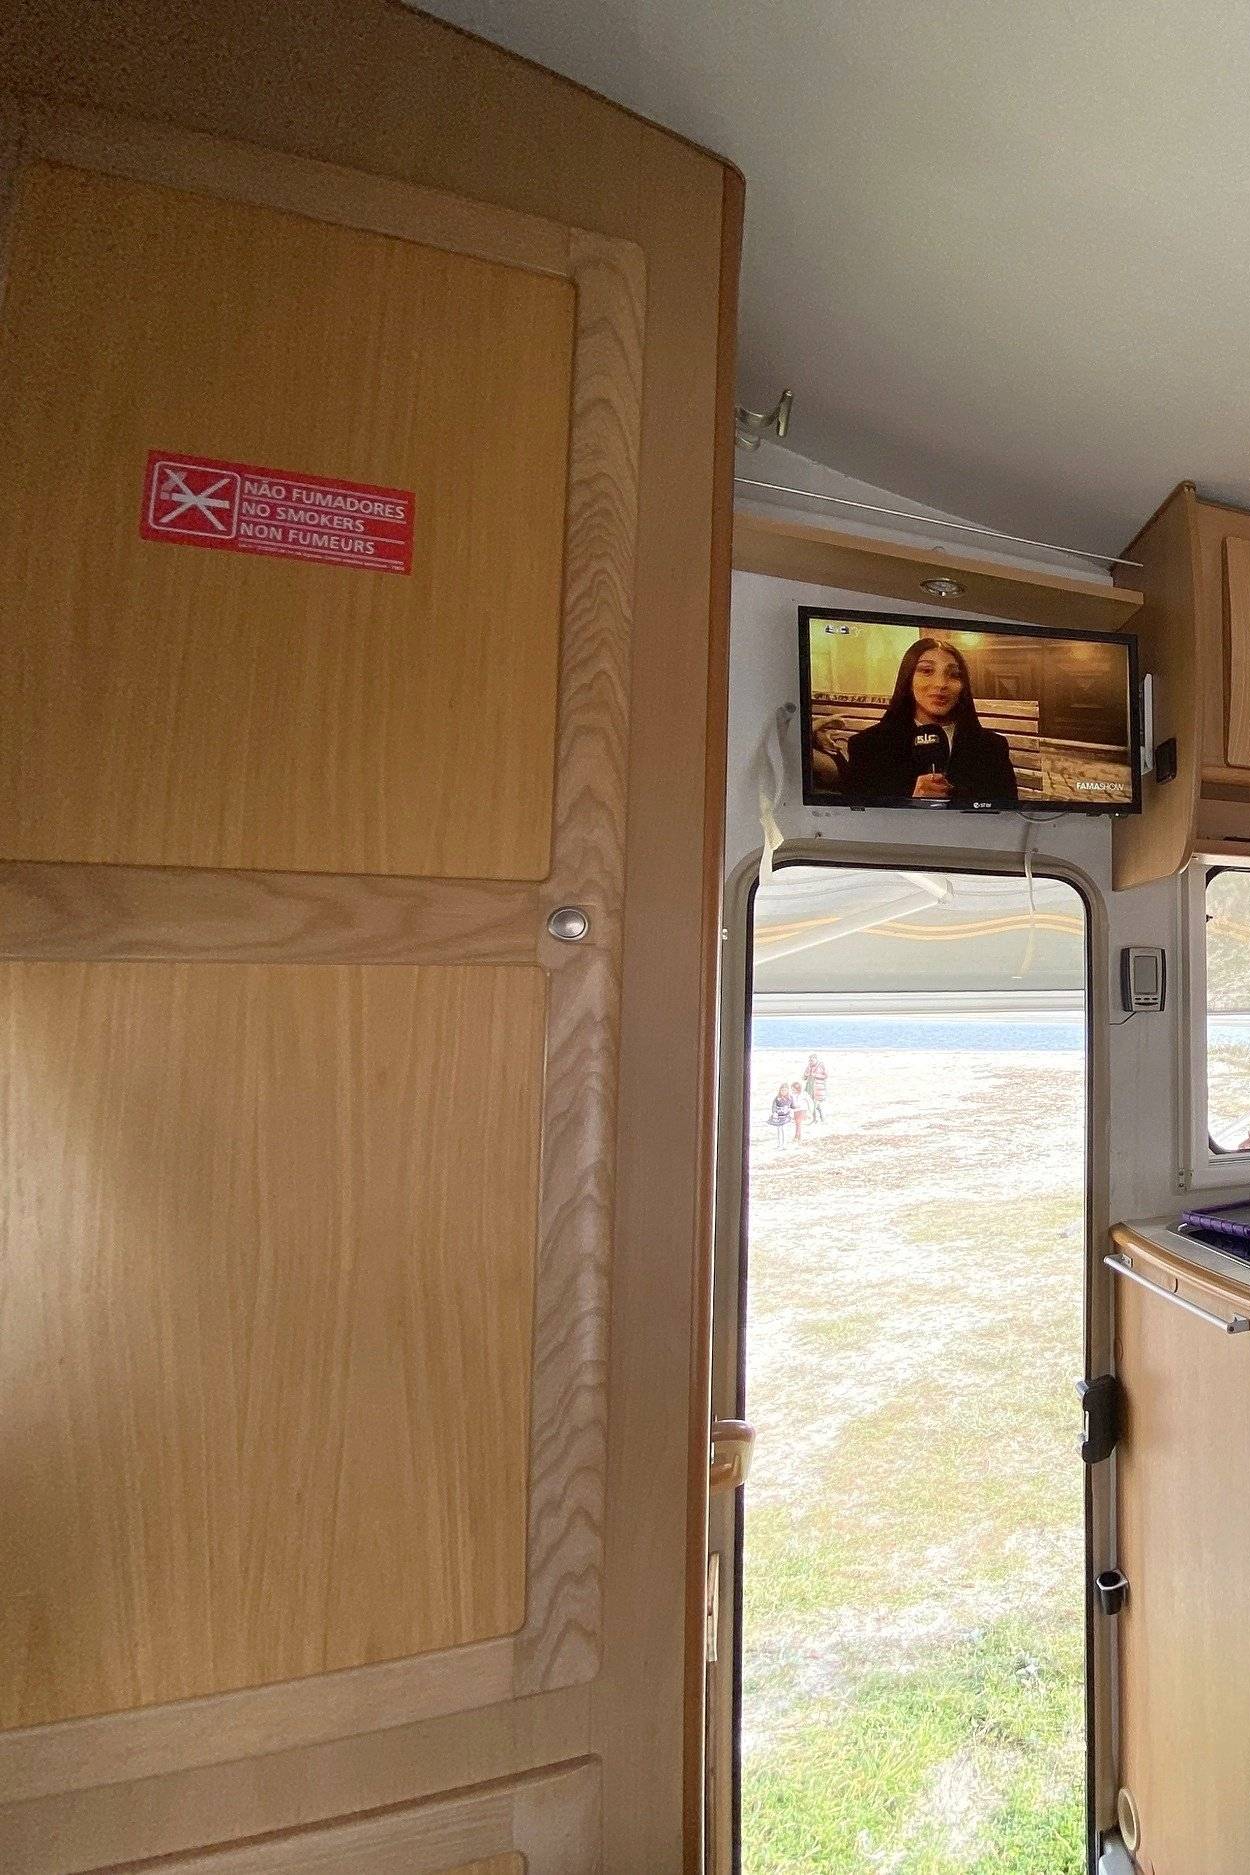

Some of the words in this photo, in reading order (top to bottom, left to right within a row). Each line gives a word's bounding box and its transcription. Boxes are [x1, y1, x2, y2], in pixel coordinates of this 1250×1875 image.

[244, 480, 286, 499] NÃO
[292, 488, 405, 519] FUMADORES
[241, 501, 271, 517] NO
[276, 507, 366, 532] SMOKERS
[239, 522, 283, 541] NON
[288, 529, 375, 555] FUMEURS
